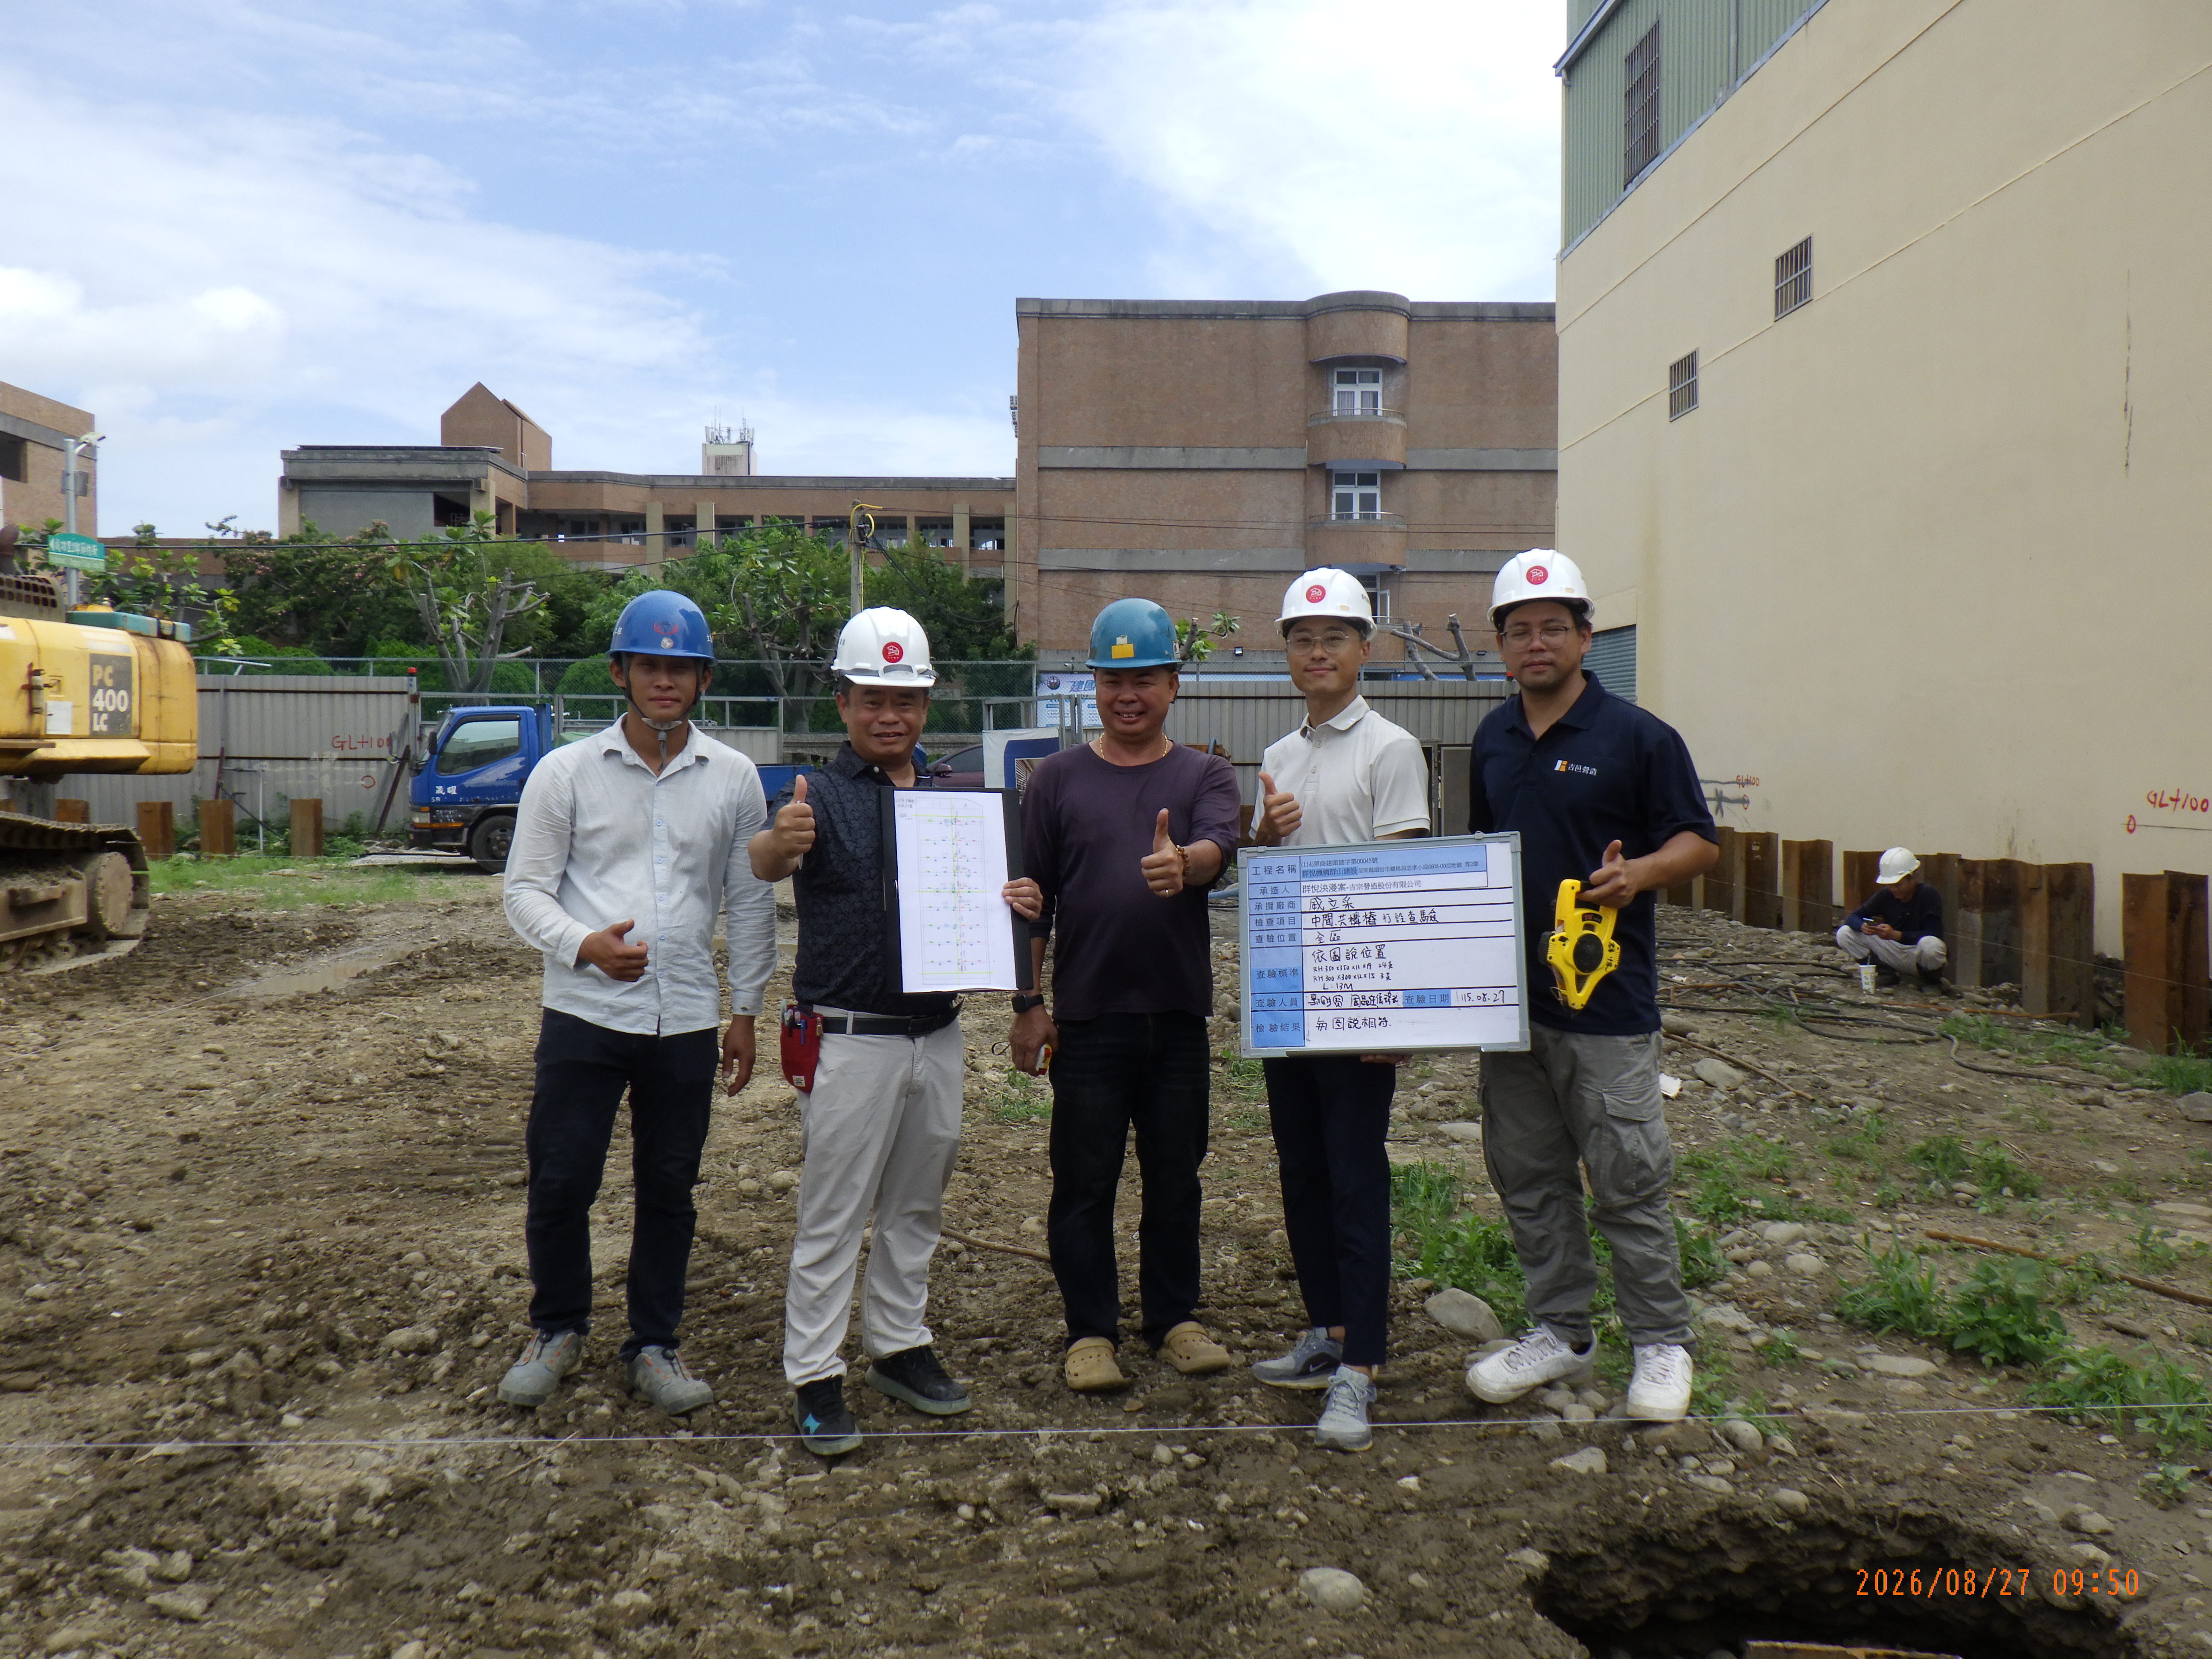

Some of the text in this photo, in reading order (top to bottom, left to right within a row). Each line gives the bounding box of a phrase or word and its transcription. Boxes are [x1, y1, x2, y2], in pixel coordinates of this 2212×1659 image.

[93, 664, 114, 687] PC
[93, 689, 128, 712] 400
[93, 713, 109, 731] LC
[1252, 864, 1296, 875] 工程名稱
[1260, 885, 1289, 895] 承造人
[1255, 901, 1295, 911] 承攬廠商
[1255, 917, 1295, 927] 檢查項目
[1255, 933, 1296, 943] 查驗位置
[1315, 929, 1342, 944] 全區
[1256, 968, 1298, 979] 查驗標準
[1256, 997, 1298, 1007] 查驗人員
[1405, 994, 1449, 1004] 查驗日期
[1256, 1022, 1301, 1033] 檢驗結果
